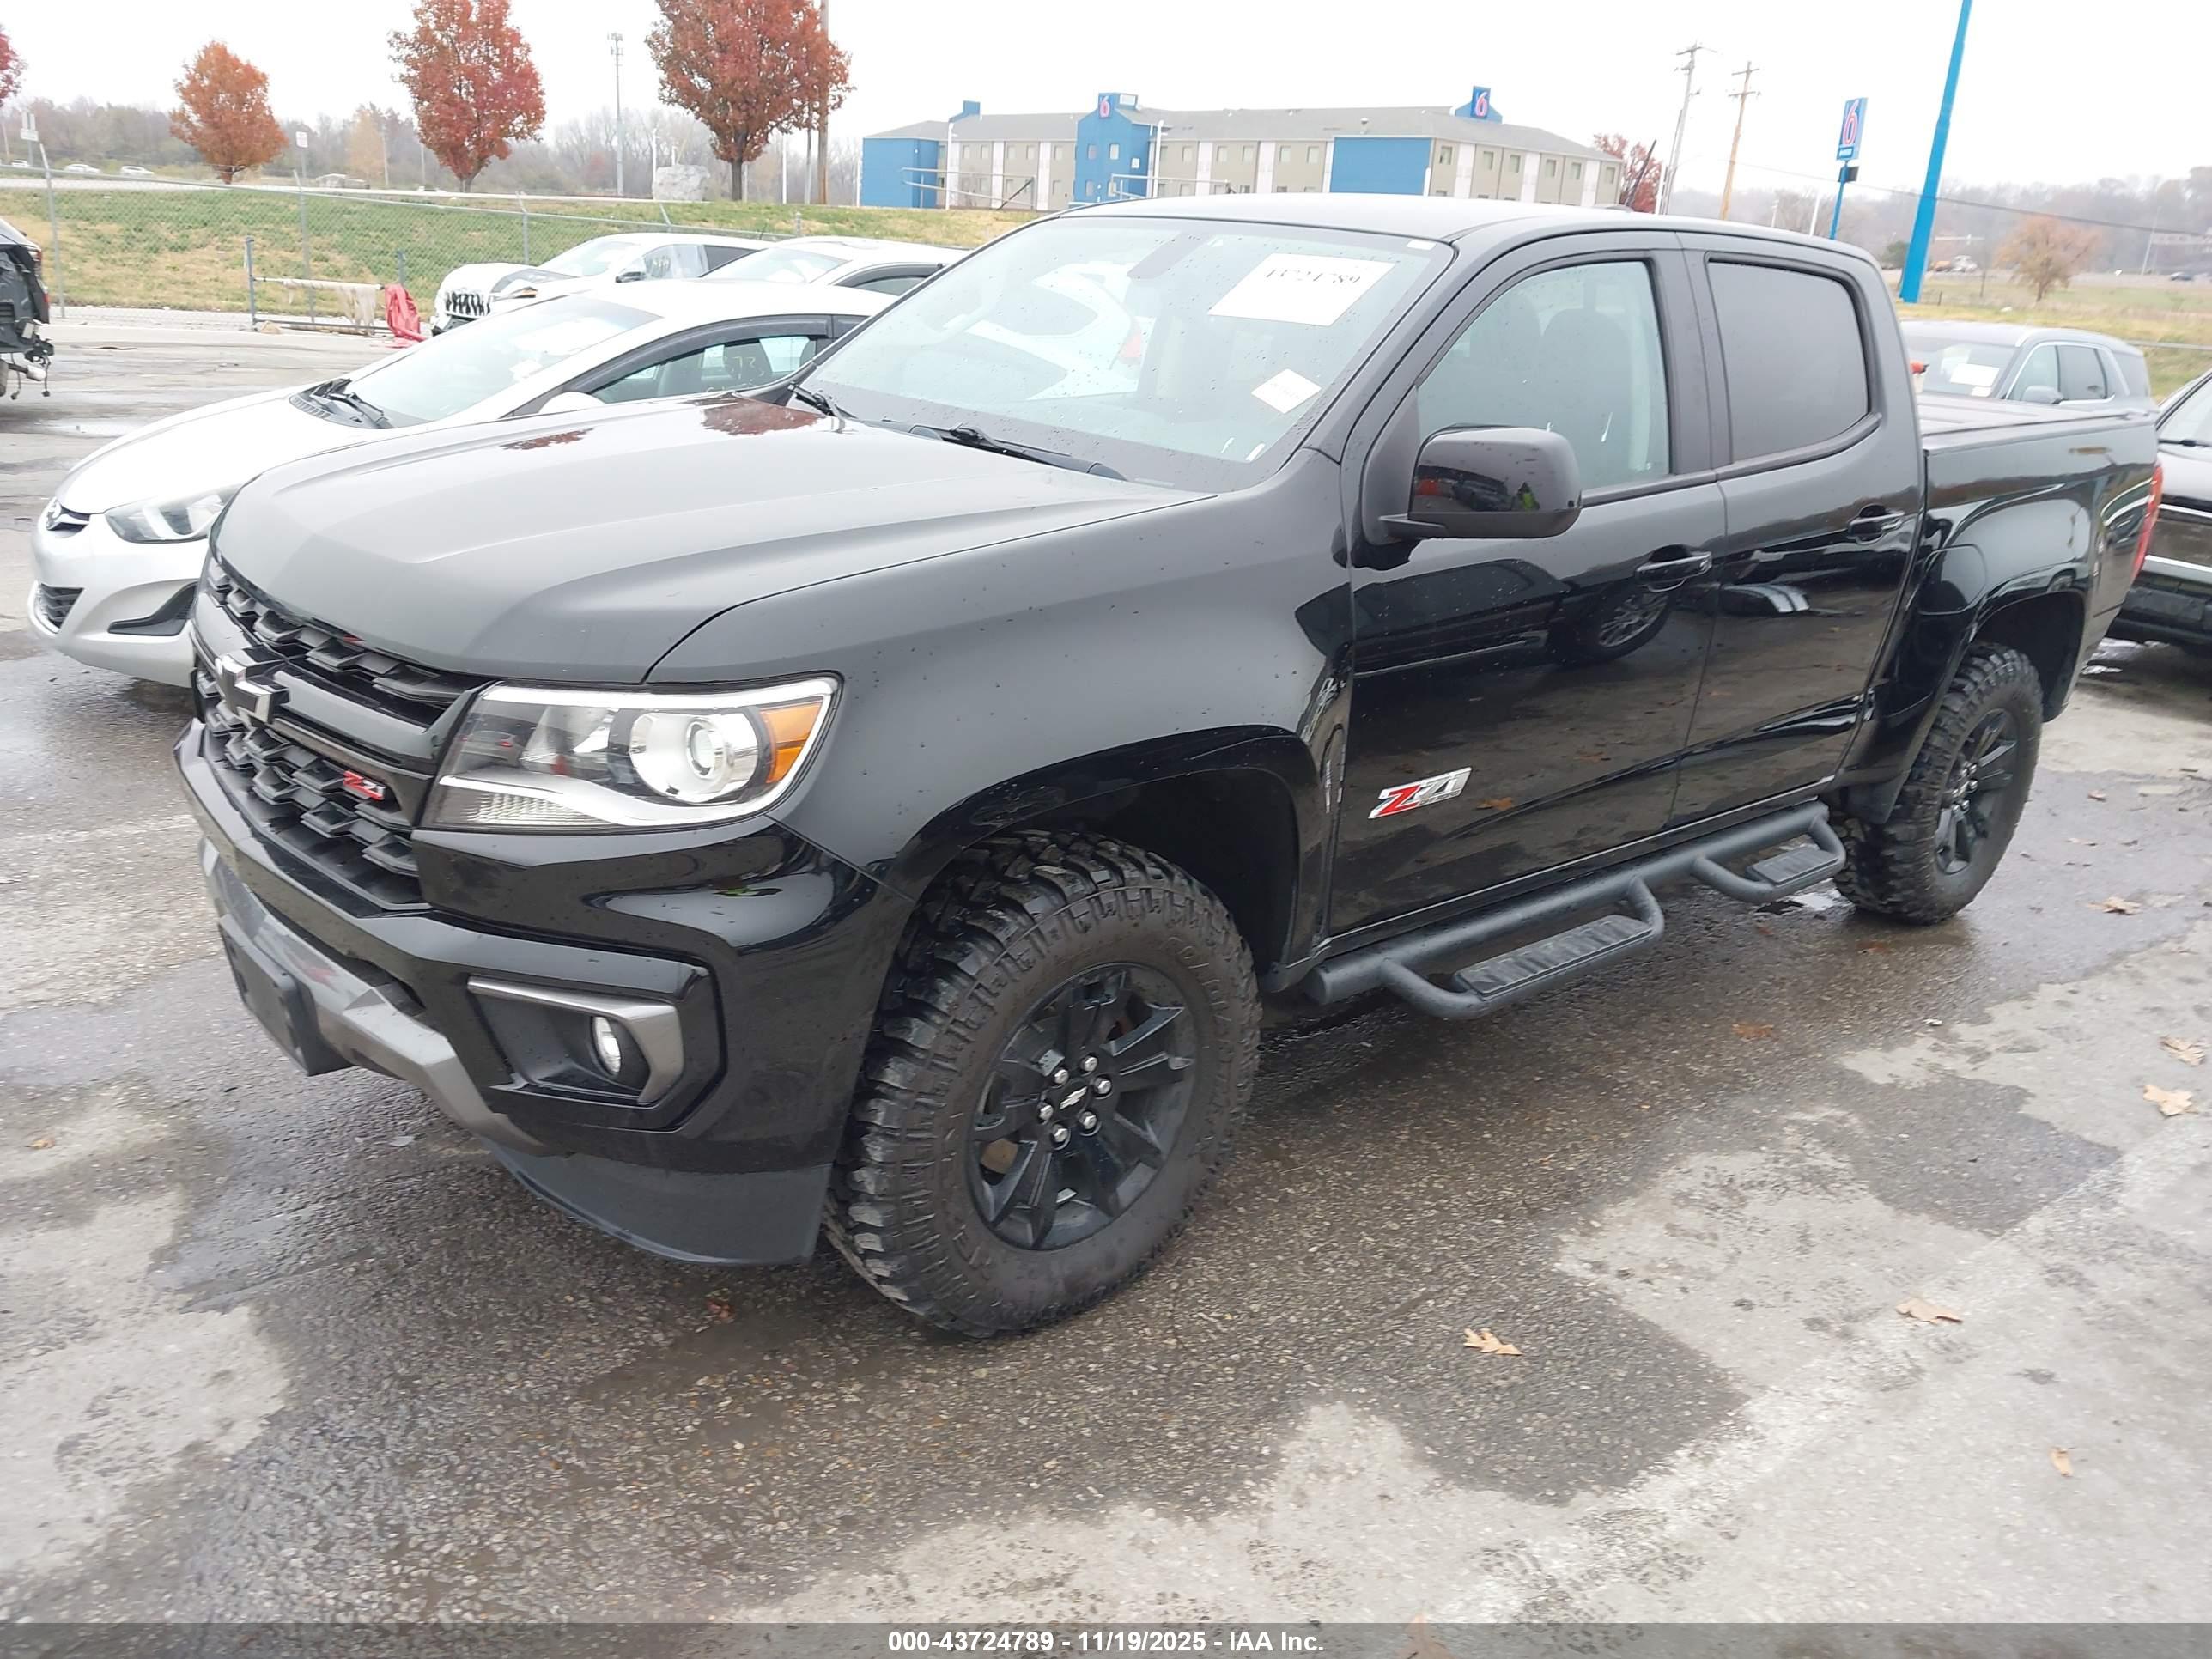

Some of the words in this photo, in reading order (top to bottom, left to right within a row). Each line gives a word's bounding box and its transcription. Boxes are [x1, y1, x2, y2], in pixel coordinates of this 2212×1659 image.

[1099, 95, 1110, 118] 6
[1474, 91, 1487, 117] 6
[1842, 98, 1858, 146] 6
[1368, 767, 1472, 819] Z71
